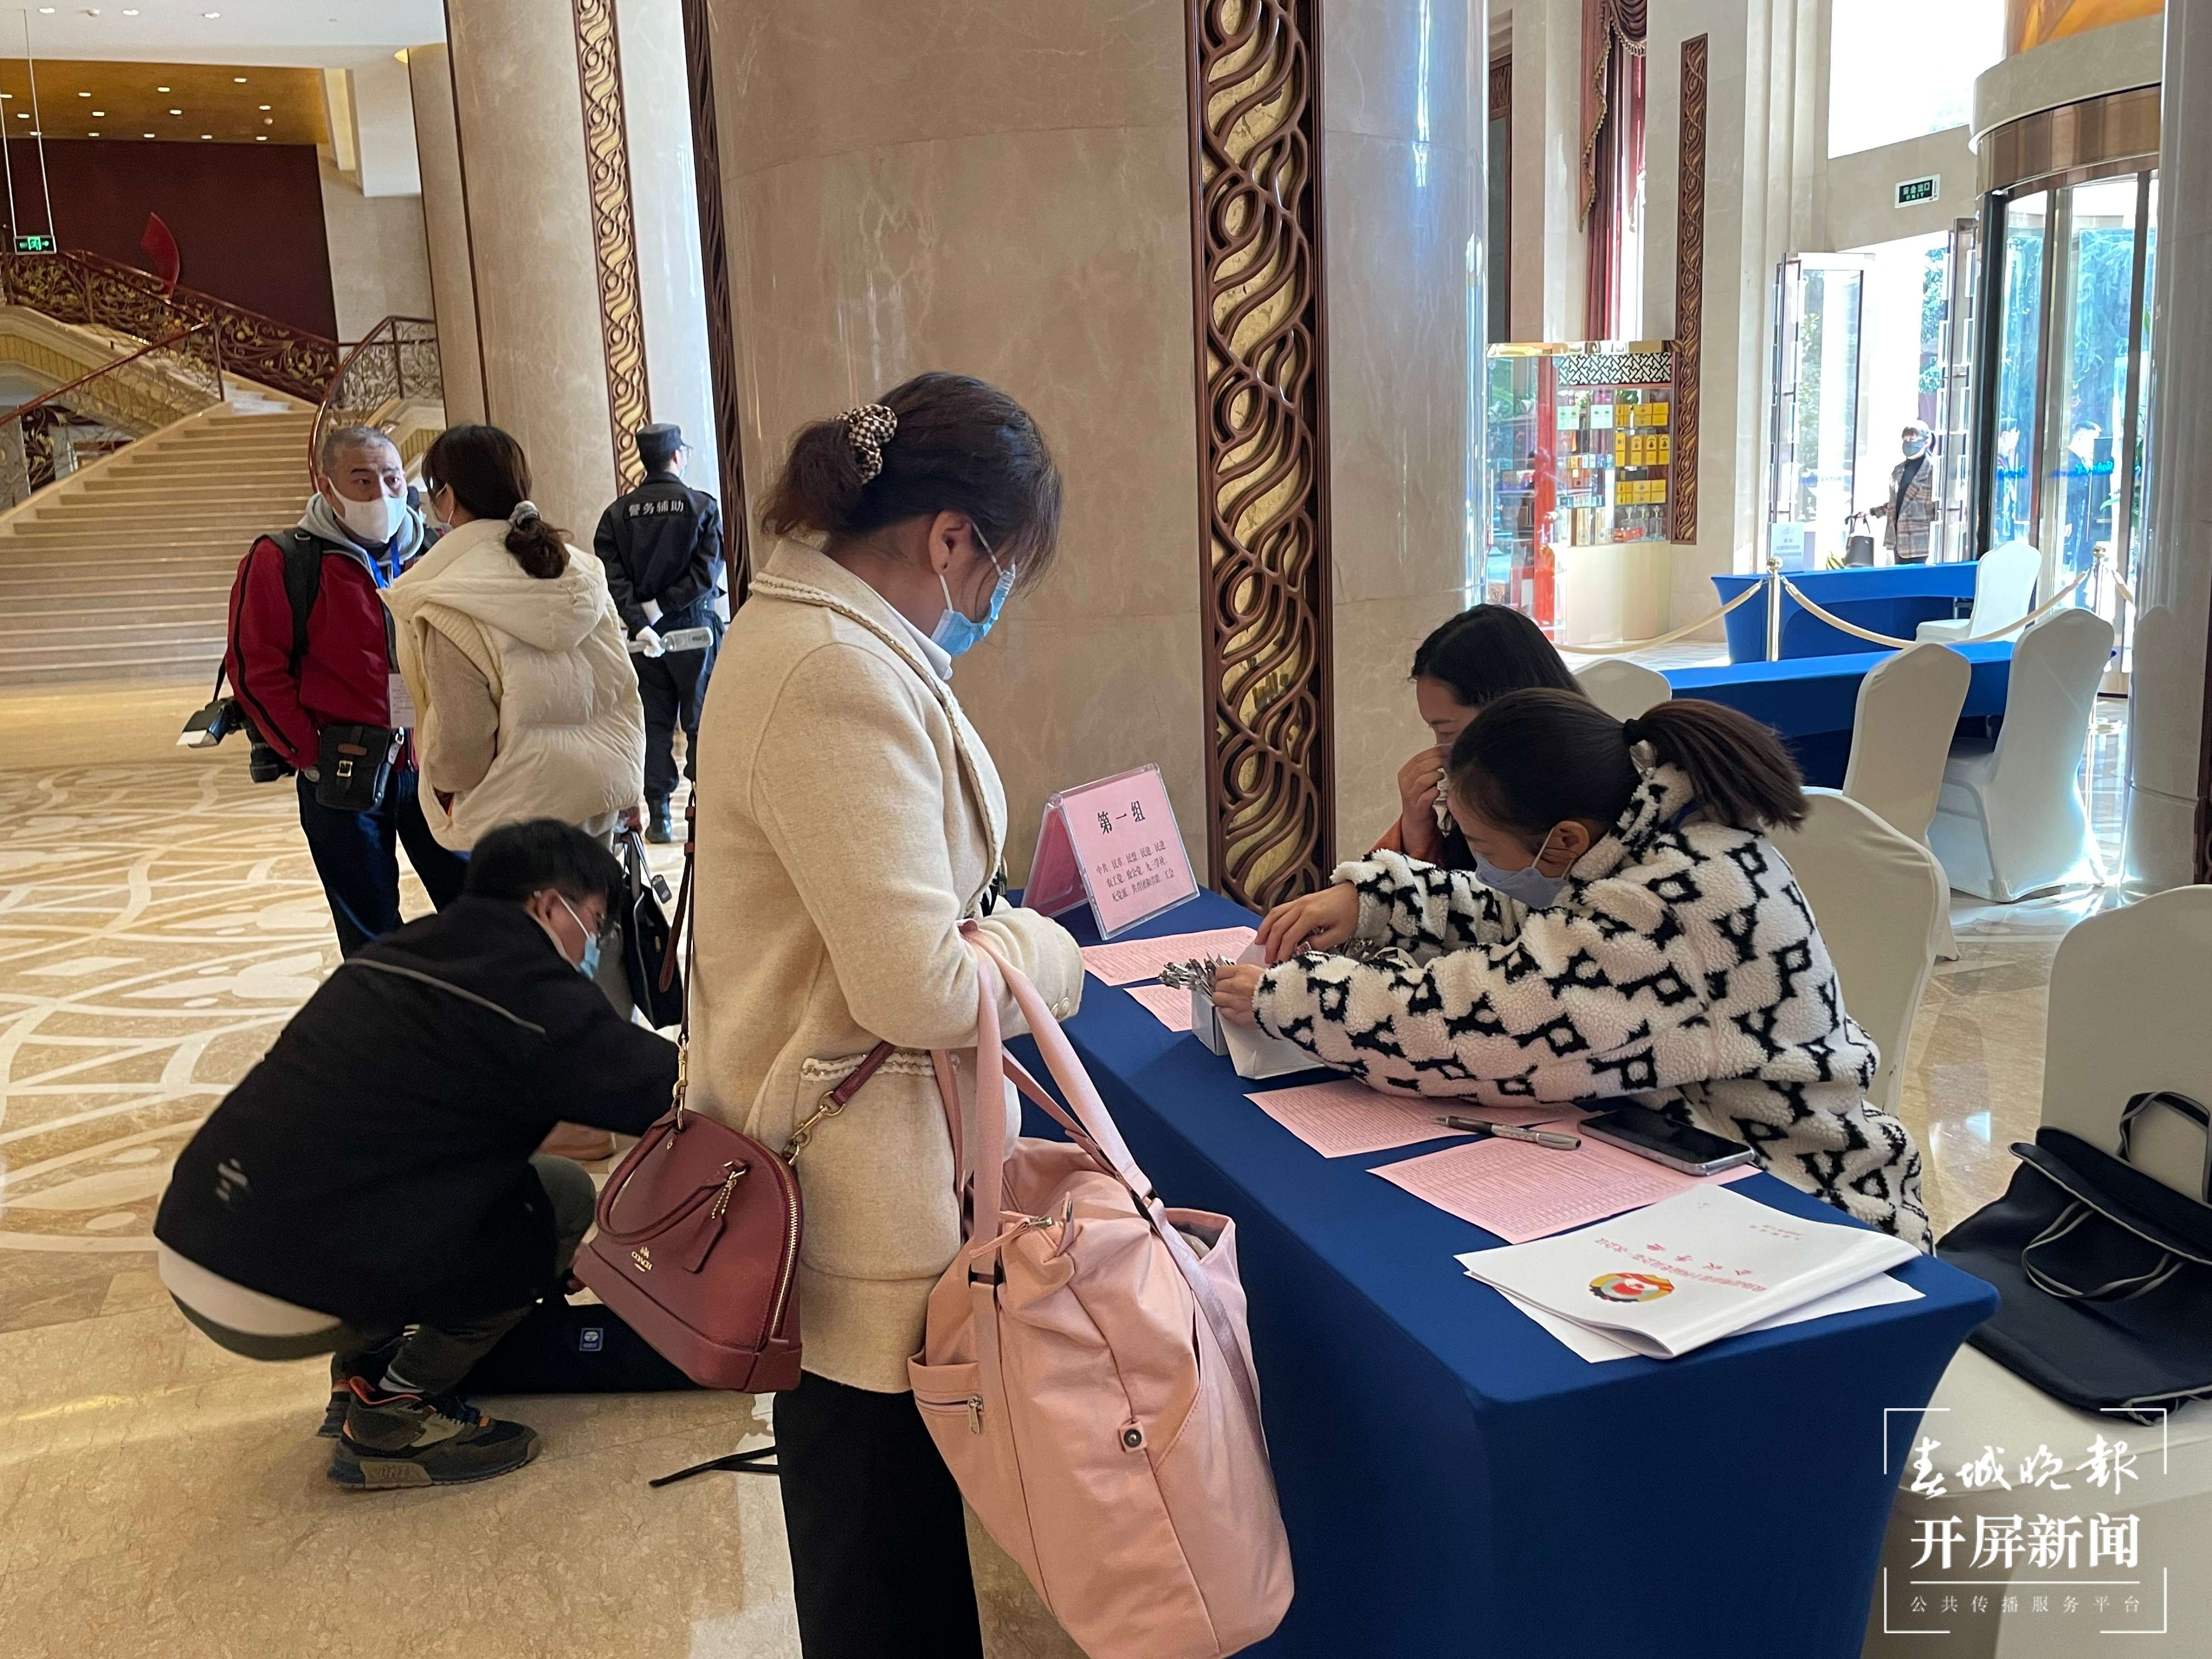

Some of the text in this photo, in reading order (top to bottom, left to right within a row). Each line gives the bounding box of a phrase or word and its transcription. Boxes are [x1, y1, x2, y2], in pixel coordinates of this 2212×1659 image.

[629, 500, 684, 517] 警务辅助
[1098, 800, 1146, 834] 第一组
